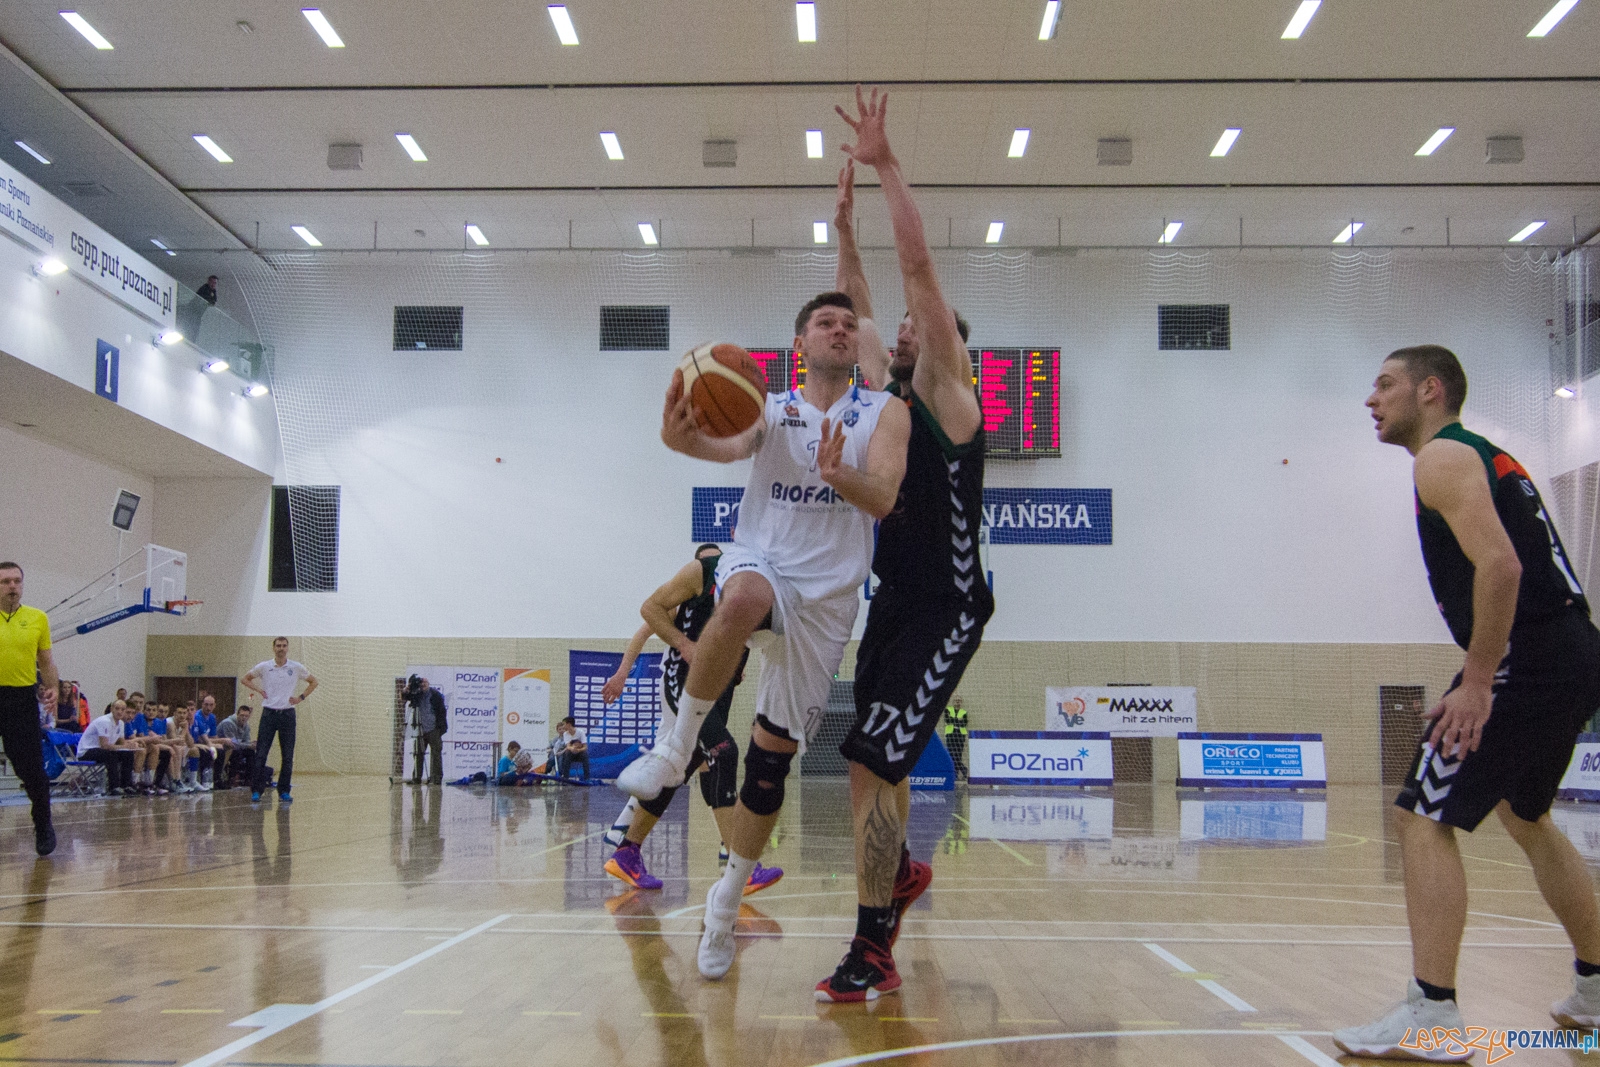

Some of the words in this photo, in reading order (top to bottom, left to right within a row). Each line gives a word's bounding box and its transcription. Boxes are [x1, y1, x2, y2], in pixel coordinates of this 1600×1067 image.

[8, 178, 30, 206] Sportu
[16, 208, 55, 249] Poznańskiej
[71, 231, 172, 316] cspp.put.poznan.pl
[103, 350, 112, 394] 1
[771, 481, 845, 504] BIOFAR
[980, 498, 1092, 529] NAŃSKA
[455, 673, 497, 682] POZnan
[454, 707, 496, 716] POZnan
[1109, 697, 1173, 713] MAXXX
[861, 701, 900, 736] 17
[1122, 714, 1138, 723] hit
[1140, 716, 1157, 724] za
[1158, 715, 1193, 723] hitem
[990, 752, 1084, 771] POZnan
[909, 776, 947, 785] TSYSTEM
